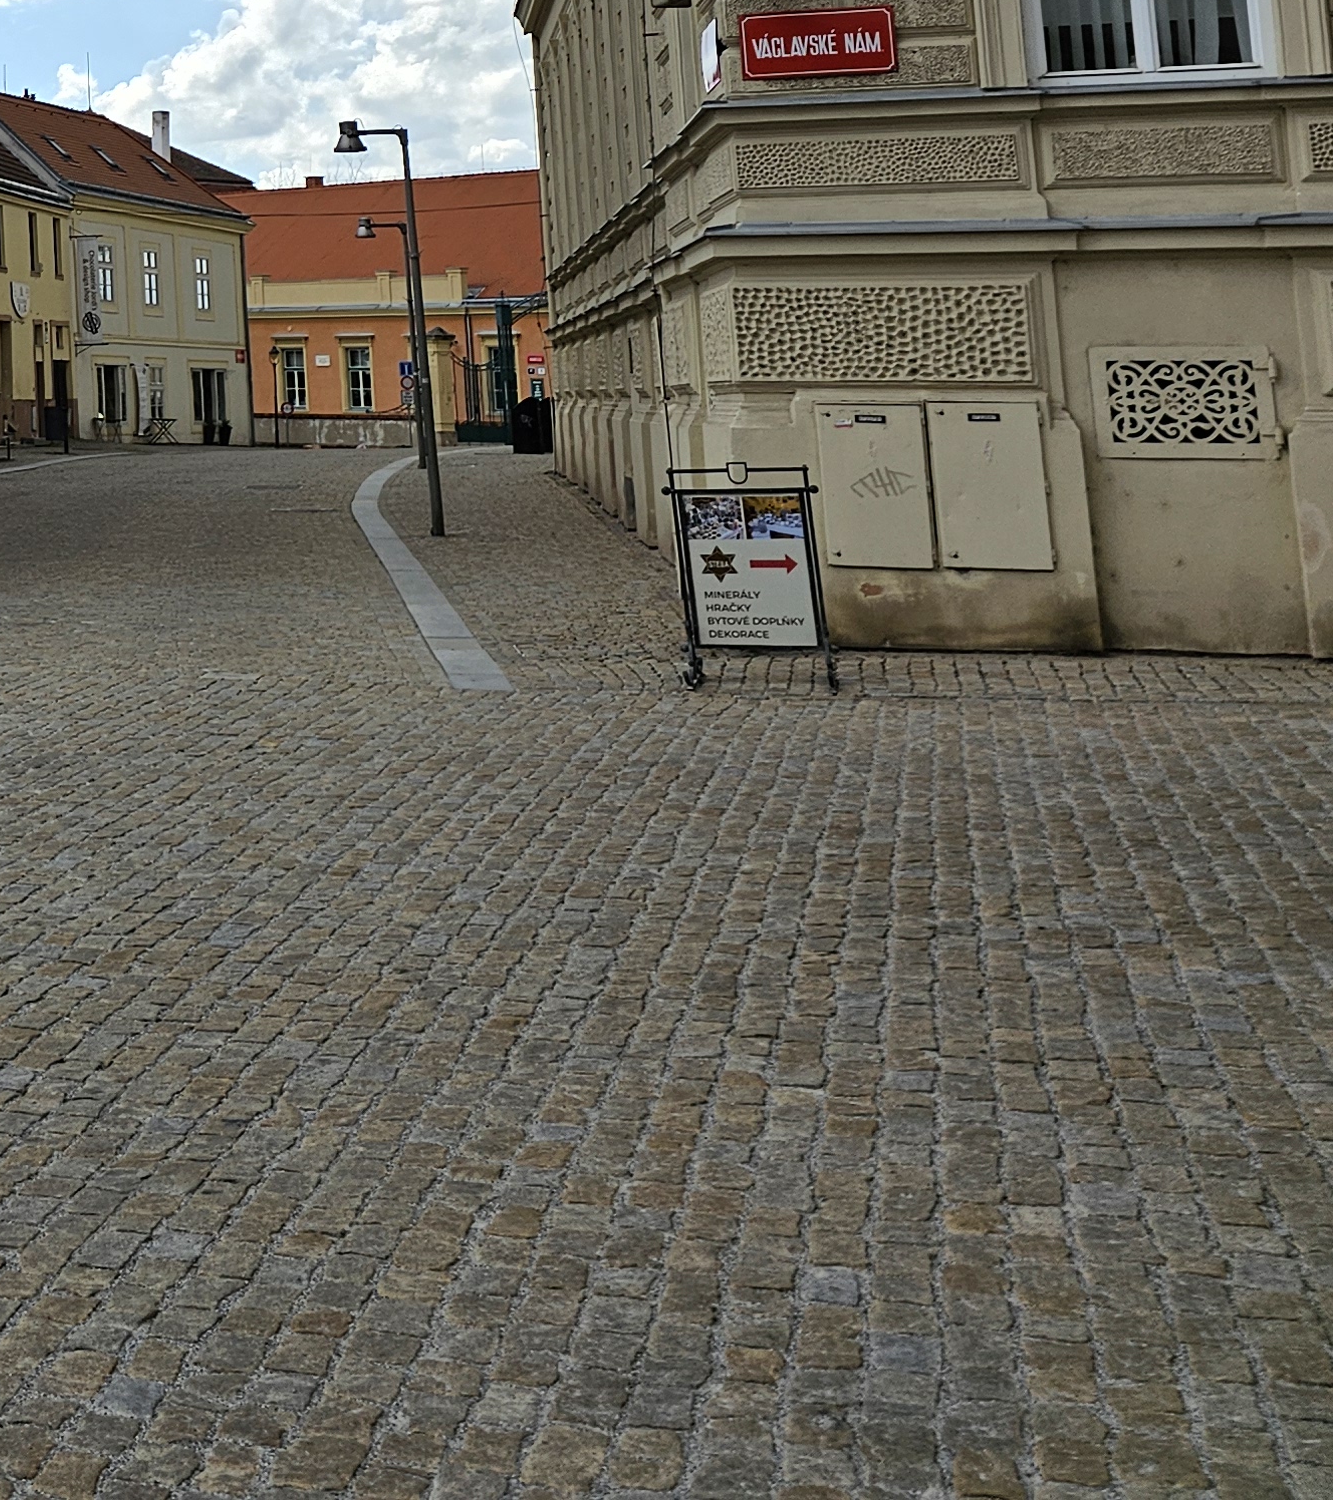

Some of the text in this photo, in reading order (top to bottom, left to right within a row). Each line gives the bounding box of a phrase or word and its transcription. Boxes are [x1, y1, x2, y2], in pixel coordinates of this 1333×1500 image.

[751, 29, 838, 59] VÁCLAVSKÉ
[704, 589, 761, 599] MINERÁLY
[705, 602, 751, 612] HRAČKY
[707, 616, 805, 626] BYTOVÉ DOPLŇKY
[709, 630, 770, 639] DEKORACE
